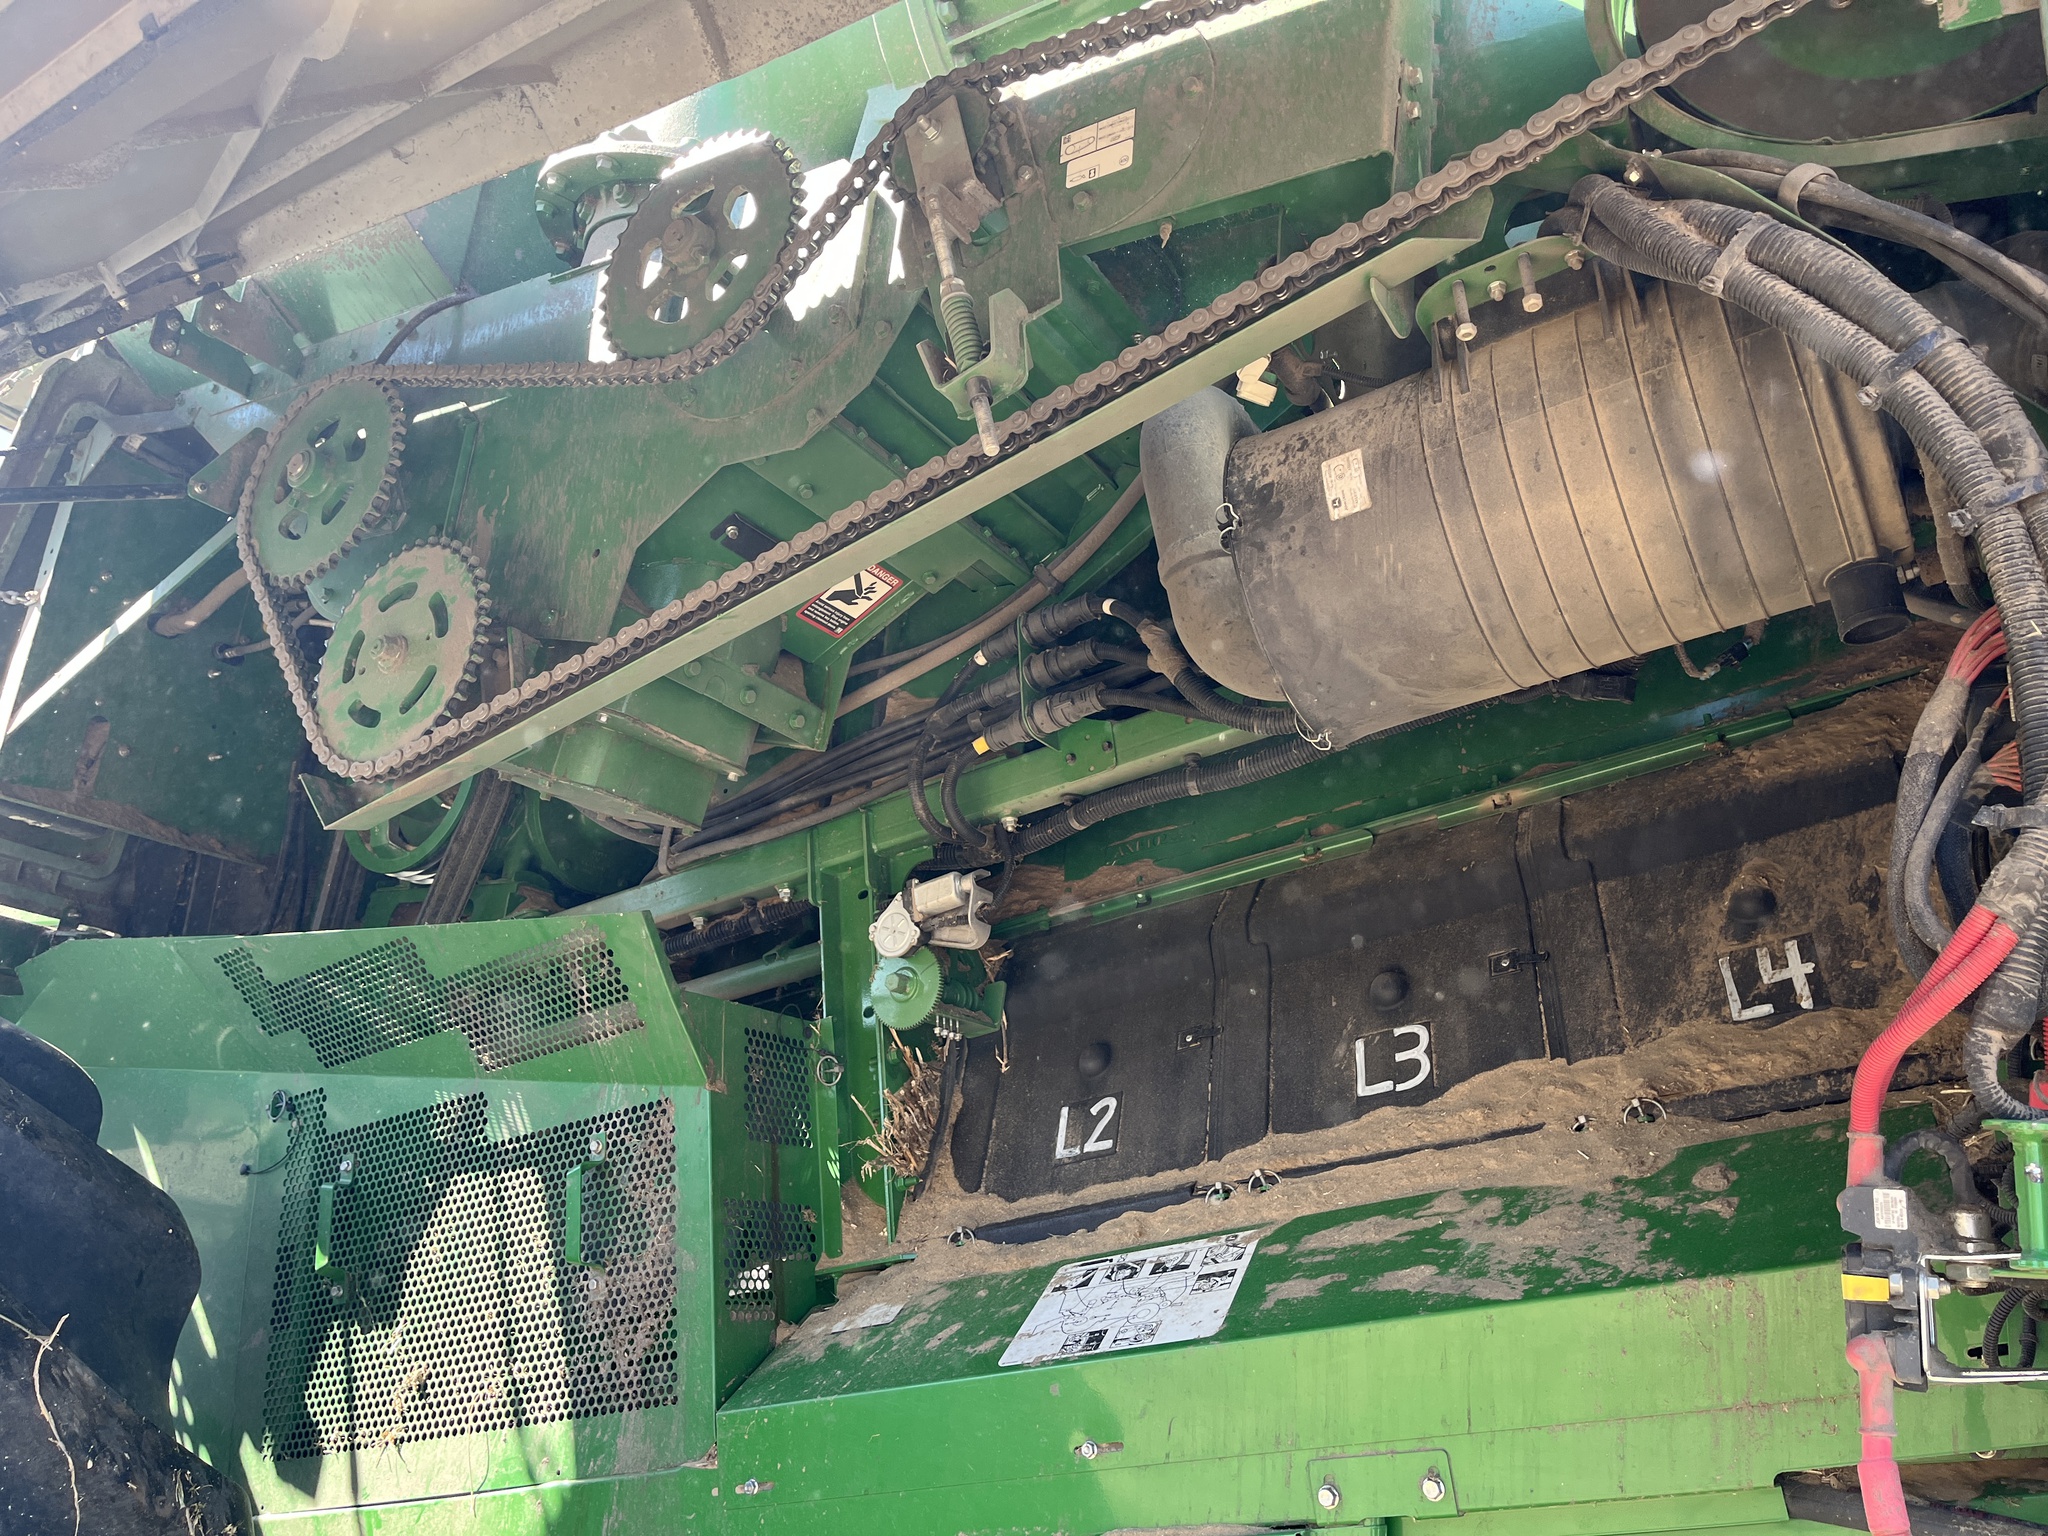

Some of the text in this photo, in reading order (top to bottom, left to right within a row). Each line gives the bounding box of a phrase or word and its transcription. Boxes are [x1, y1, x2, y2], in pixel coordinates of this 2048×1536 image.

[867, 564, 899, 587] DANGER
[1719, 940, 1815, 1021] L4
[1355, 1024, 1431, 1097] L3
[1055, 1096, 1118, 1159] L2
